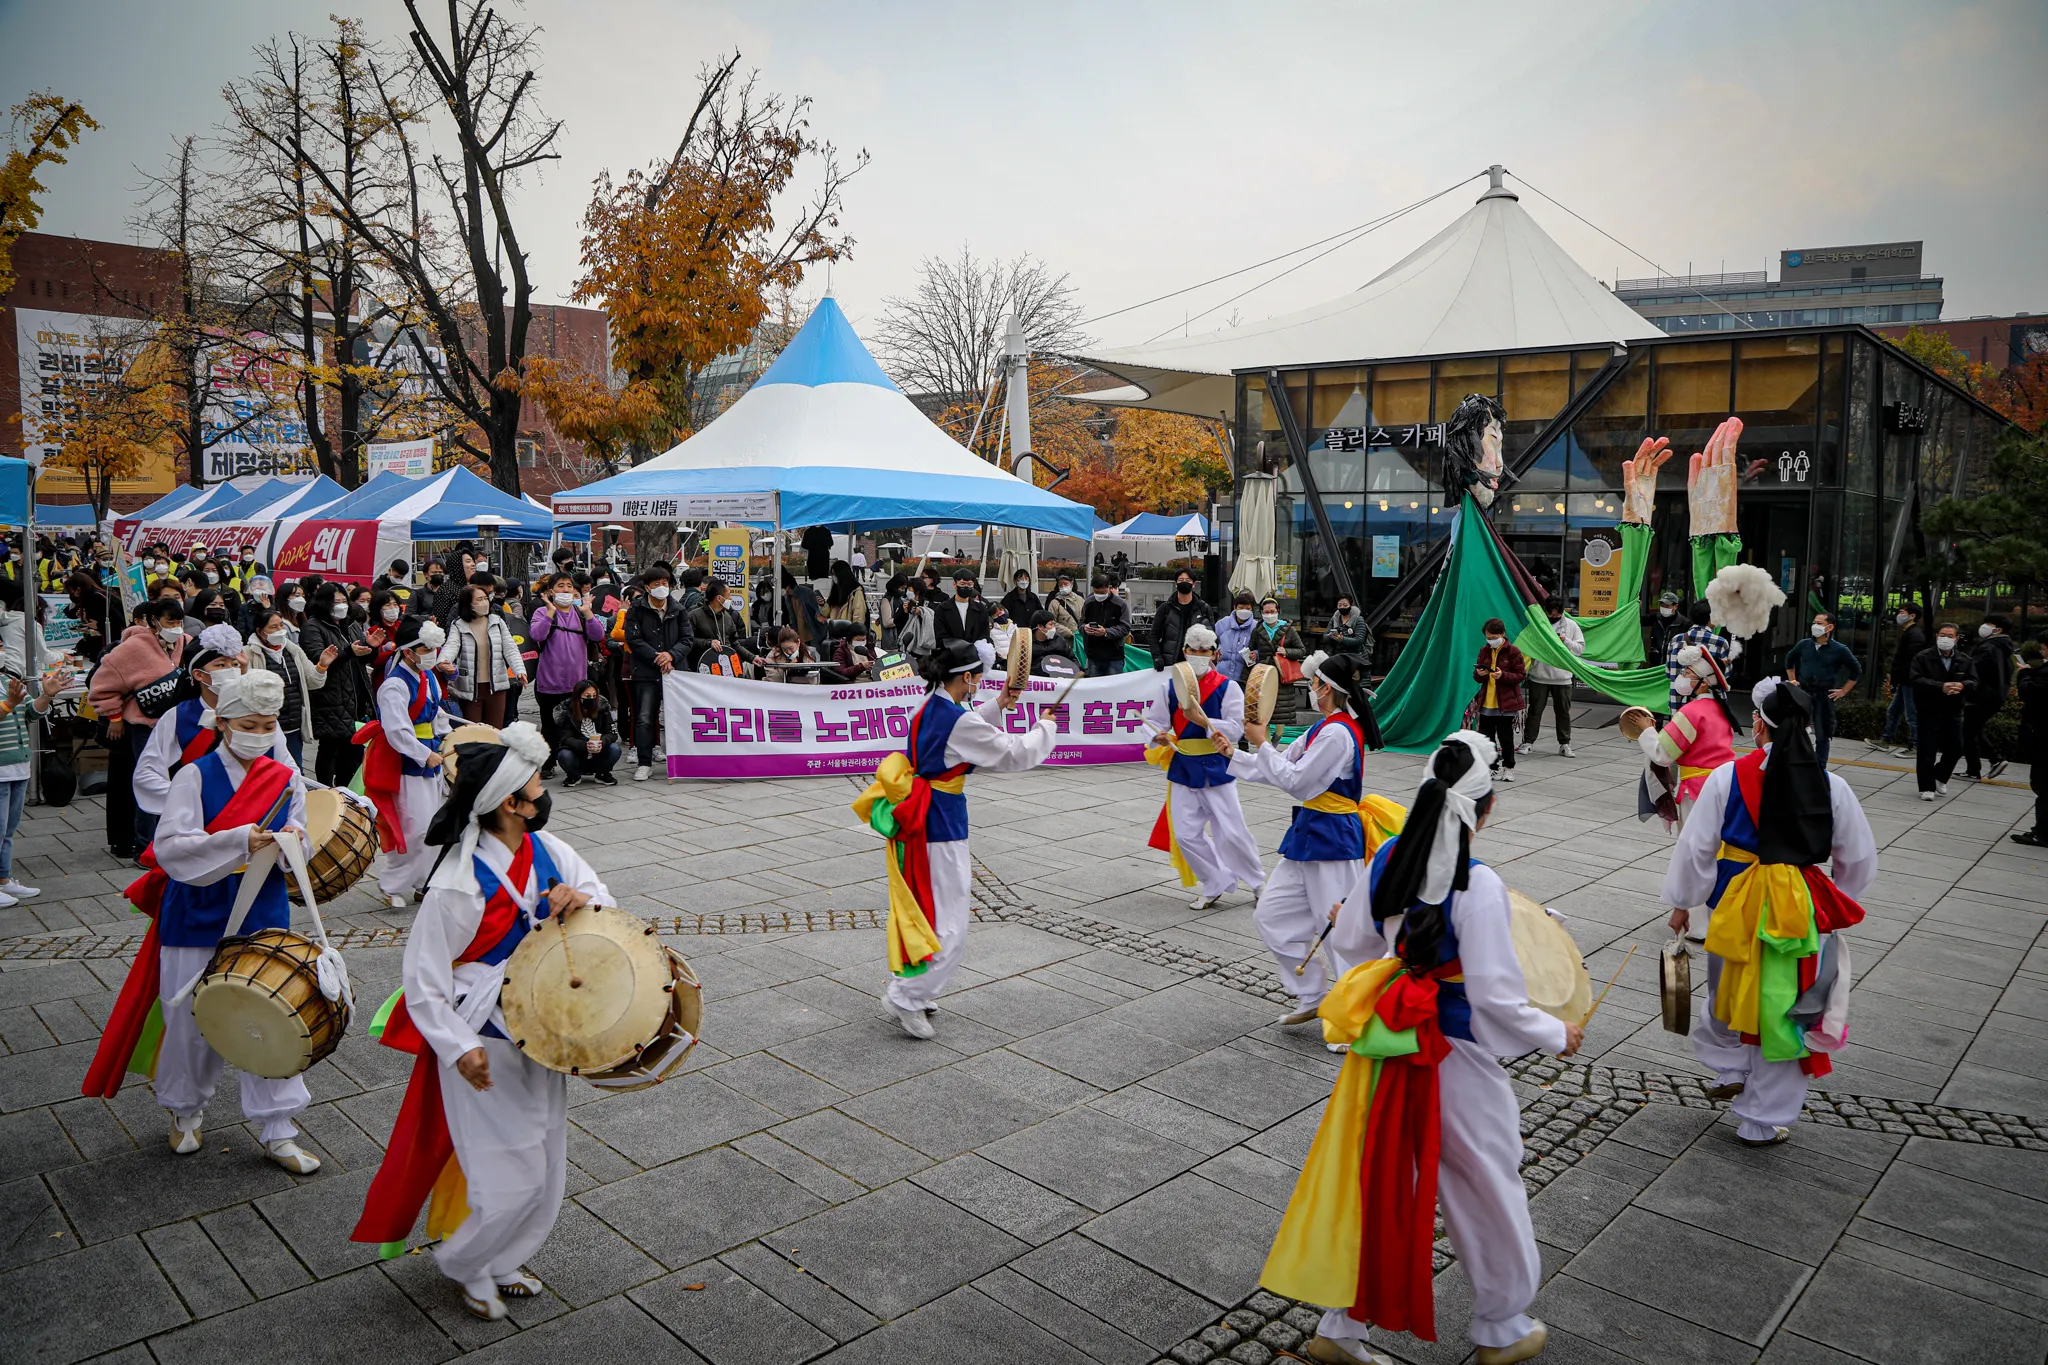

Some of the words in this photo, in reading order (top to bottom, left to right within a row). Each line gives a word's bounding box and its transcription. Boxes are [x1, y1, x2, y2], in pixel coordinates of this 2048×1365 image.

[1803, 246, 1916, 264] 한국방송통신대학교
[1325, 426, 1392, 451] 플러스
[1401, 422, 1447, 449] 카페
[622, 500, 649, 517] 대항로
[650, 500, 678, 516] 사람들
[308, 527, 356, 574] 연내
[712, 560, 737, 573] 안심콜
[830, 689, 862, 700] 2021
[691, 707, 804, 744] 권리를
[973, 700, 1071, 735] 리를
[1082, 699, 1154, 735] 춤추
